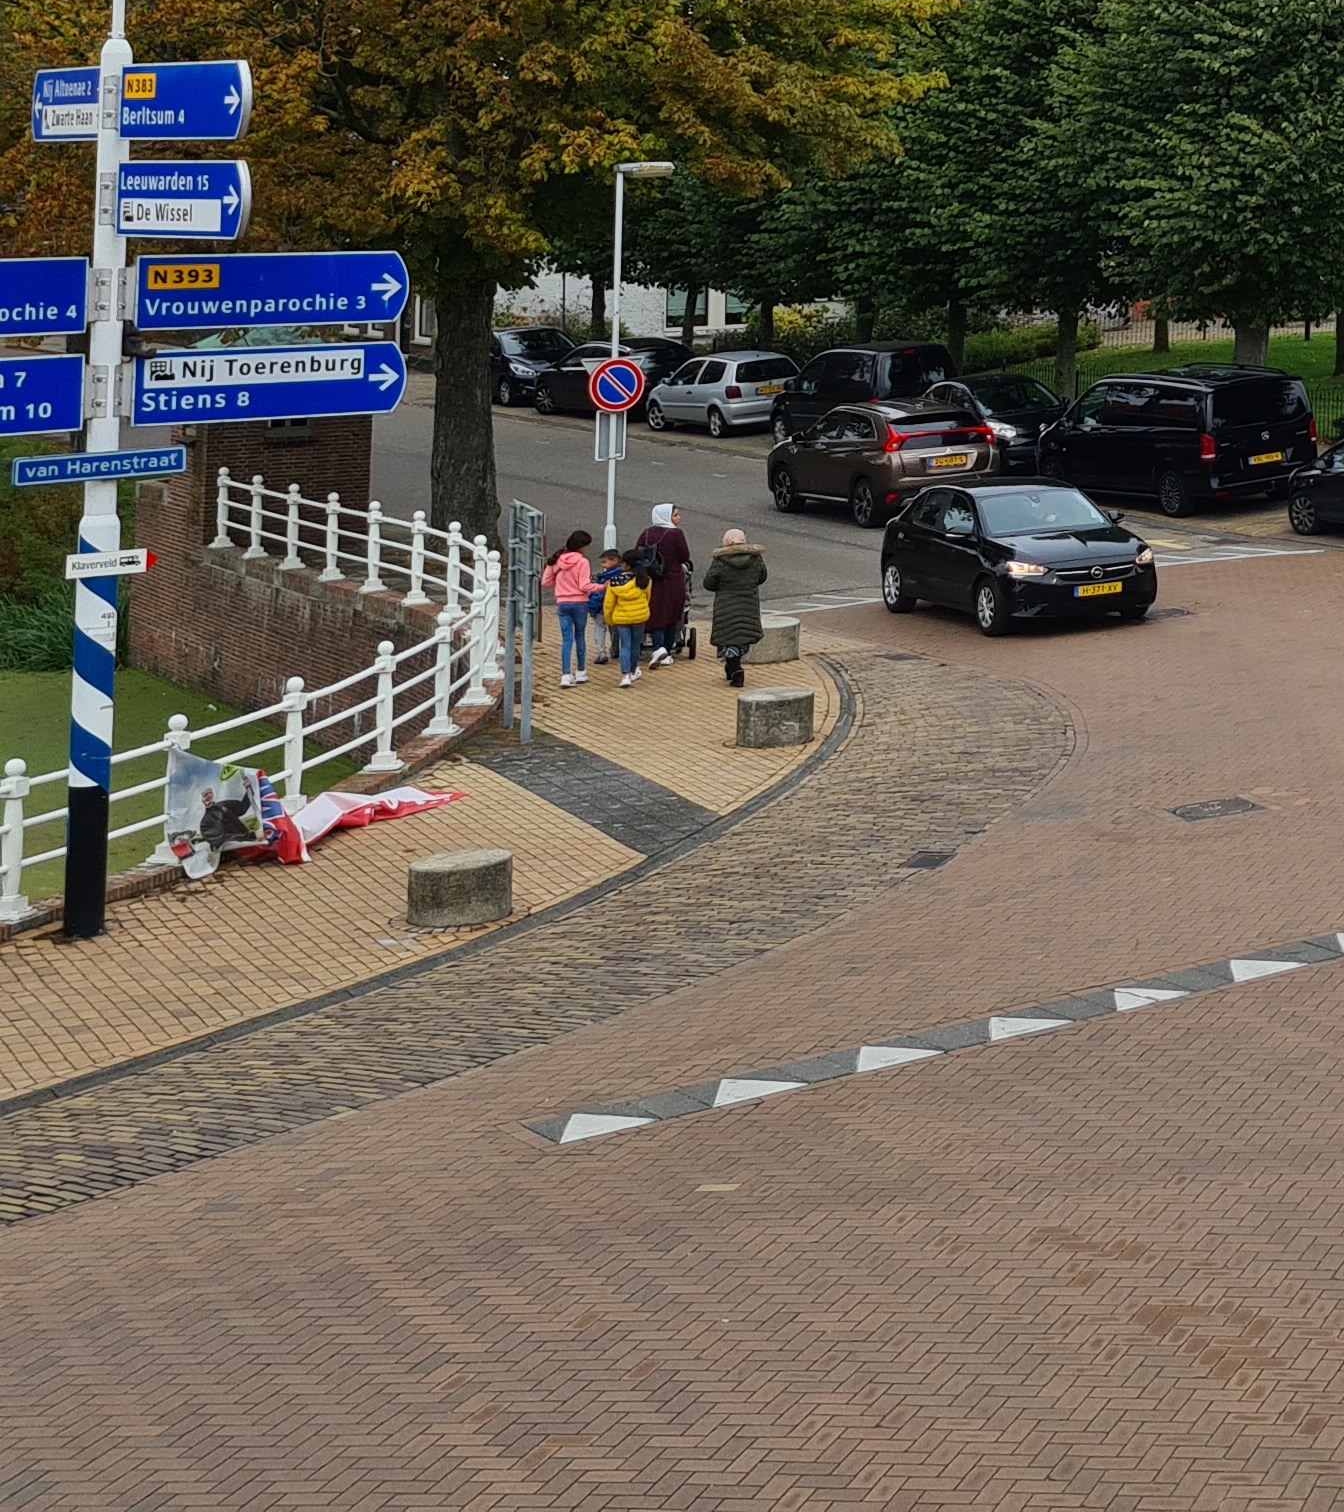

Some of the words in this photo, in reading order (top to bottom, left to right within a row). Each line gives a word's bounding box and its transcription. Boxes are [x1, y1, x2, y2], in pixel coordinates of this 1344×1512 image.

[86, 80, 92, 96] 2
[126, 78, 154, 94] N383
[51, 109, 74, 127] Zwarte
[75, 108, 93, 126] Haan
[122, 106, 175, 125] Berltsum
[177, 109, 185, 125] 4
[120, 171, 194, 191] Leeuwarden
[196, 175, 209, 191] 15
[136, 204, 151, 222] De
[155, 204, 193, 222] Wissel
[66, 304, 78, 319] 4
[145, 292, 349, 317] Vrouwenparochie
[355, 295, 367, 310] 3
[182, 360, 215, 382] Nij
[224, 354, 362, 377] Toerenburg
[14, 371, 27, 388] 7
[141, 390, 227, 412] Stiens
[237, 390, 250, 407] 8
[25, 402, 52, 419] 10
[26, 464, 59, 478] van
[67, 452, 178, 474] Harenstraat
[71, 558, 118, 571] Klaverveld
